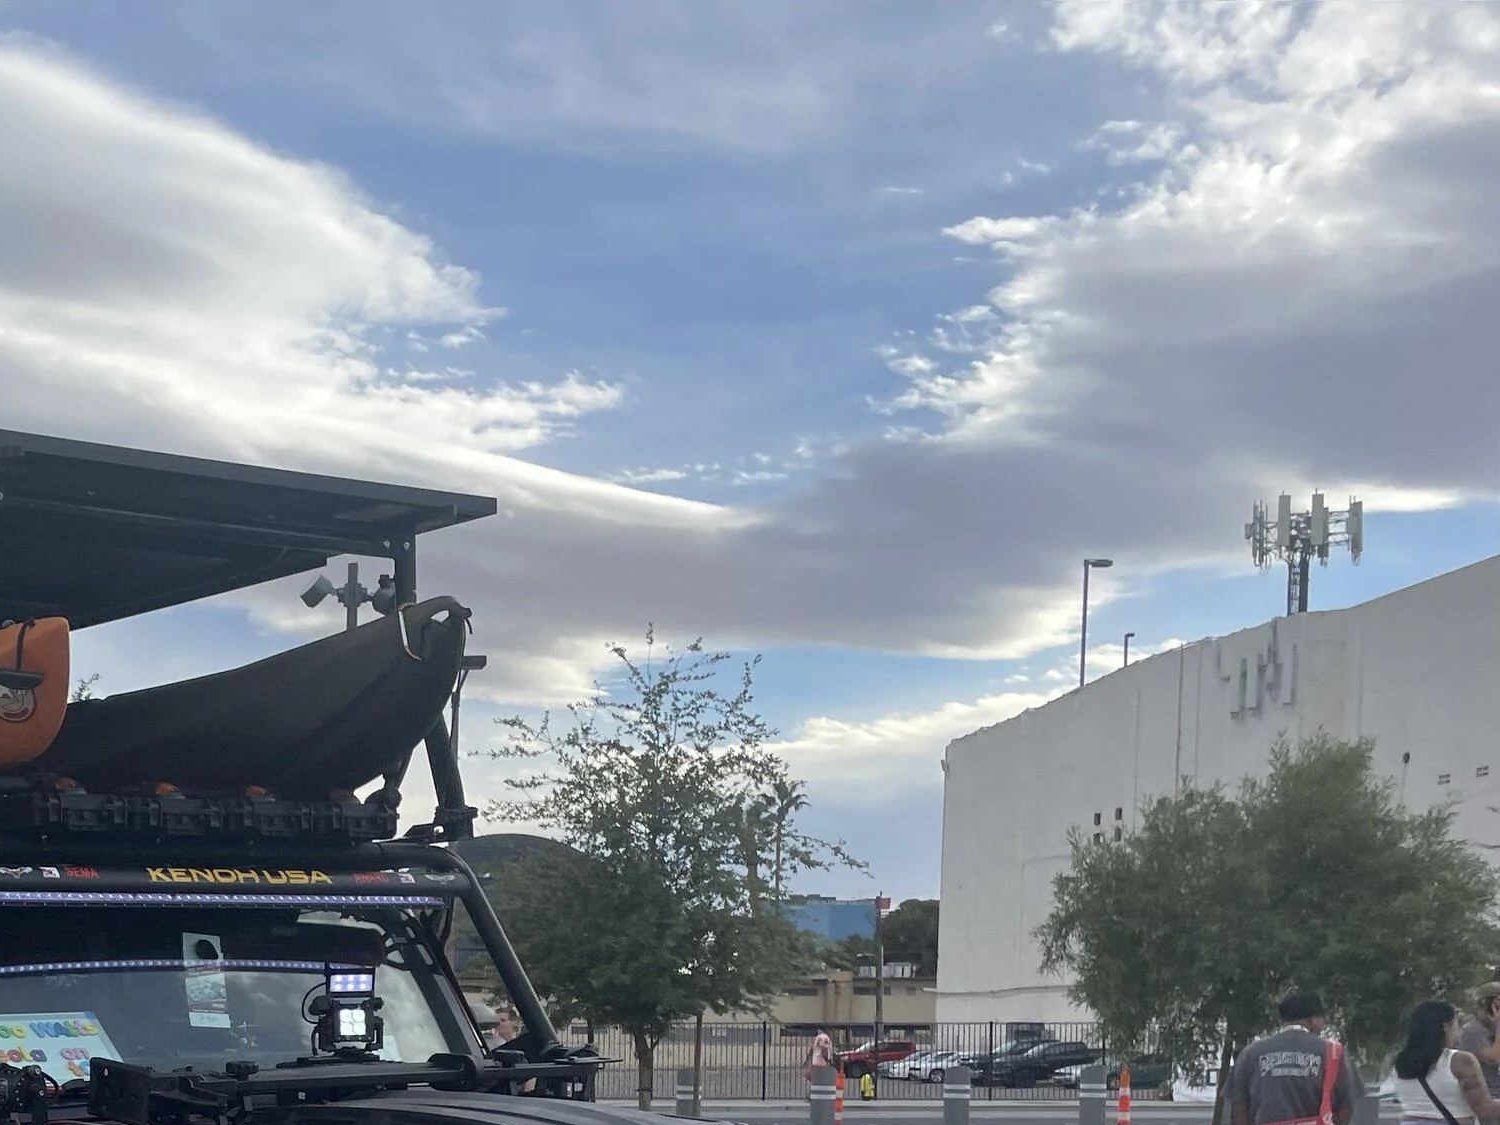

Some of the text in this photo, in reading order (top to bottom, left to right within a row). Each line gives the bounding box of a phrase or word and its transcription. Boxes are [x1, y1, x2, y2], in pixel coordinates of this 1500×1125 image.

[63, 866, 99, 879] SEMA
[146, 867, 333, 884] KENOH USA
